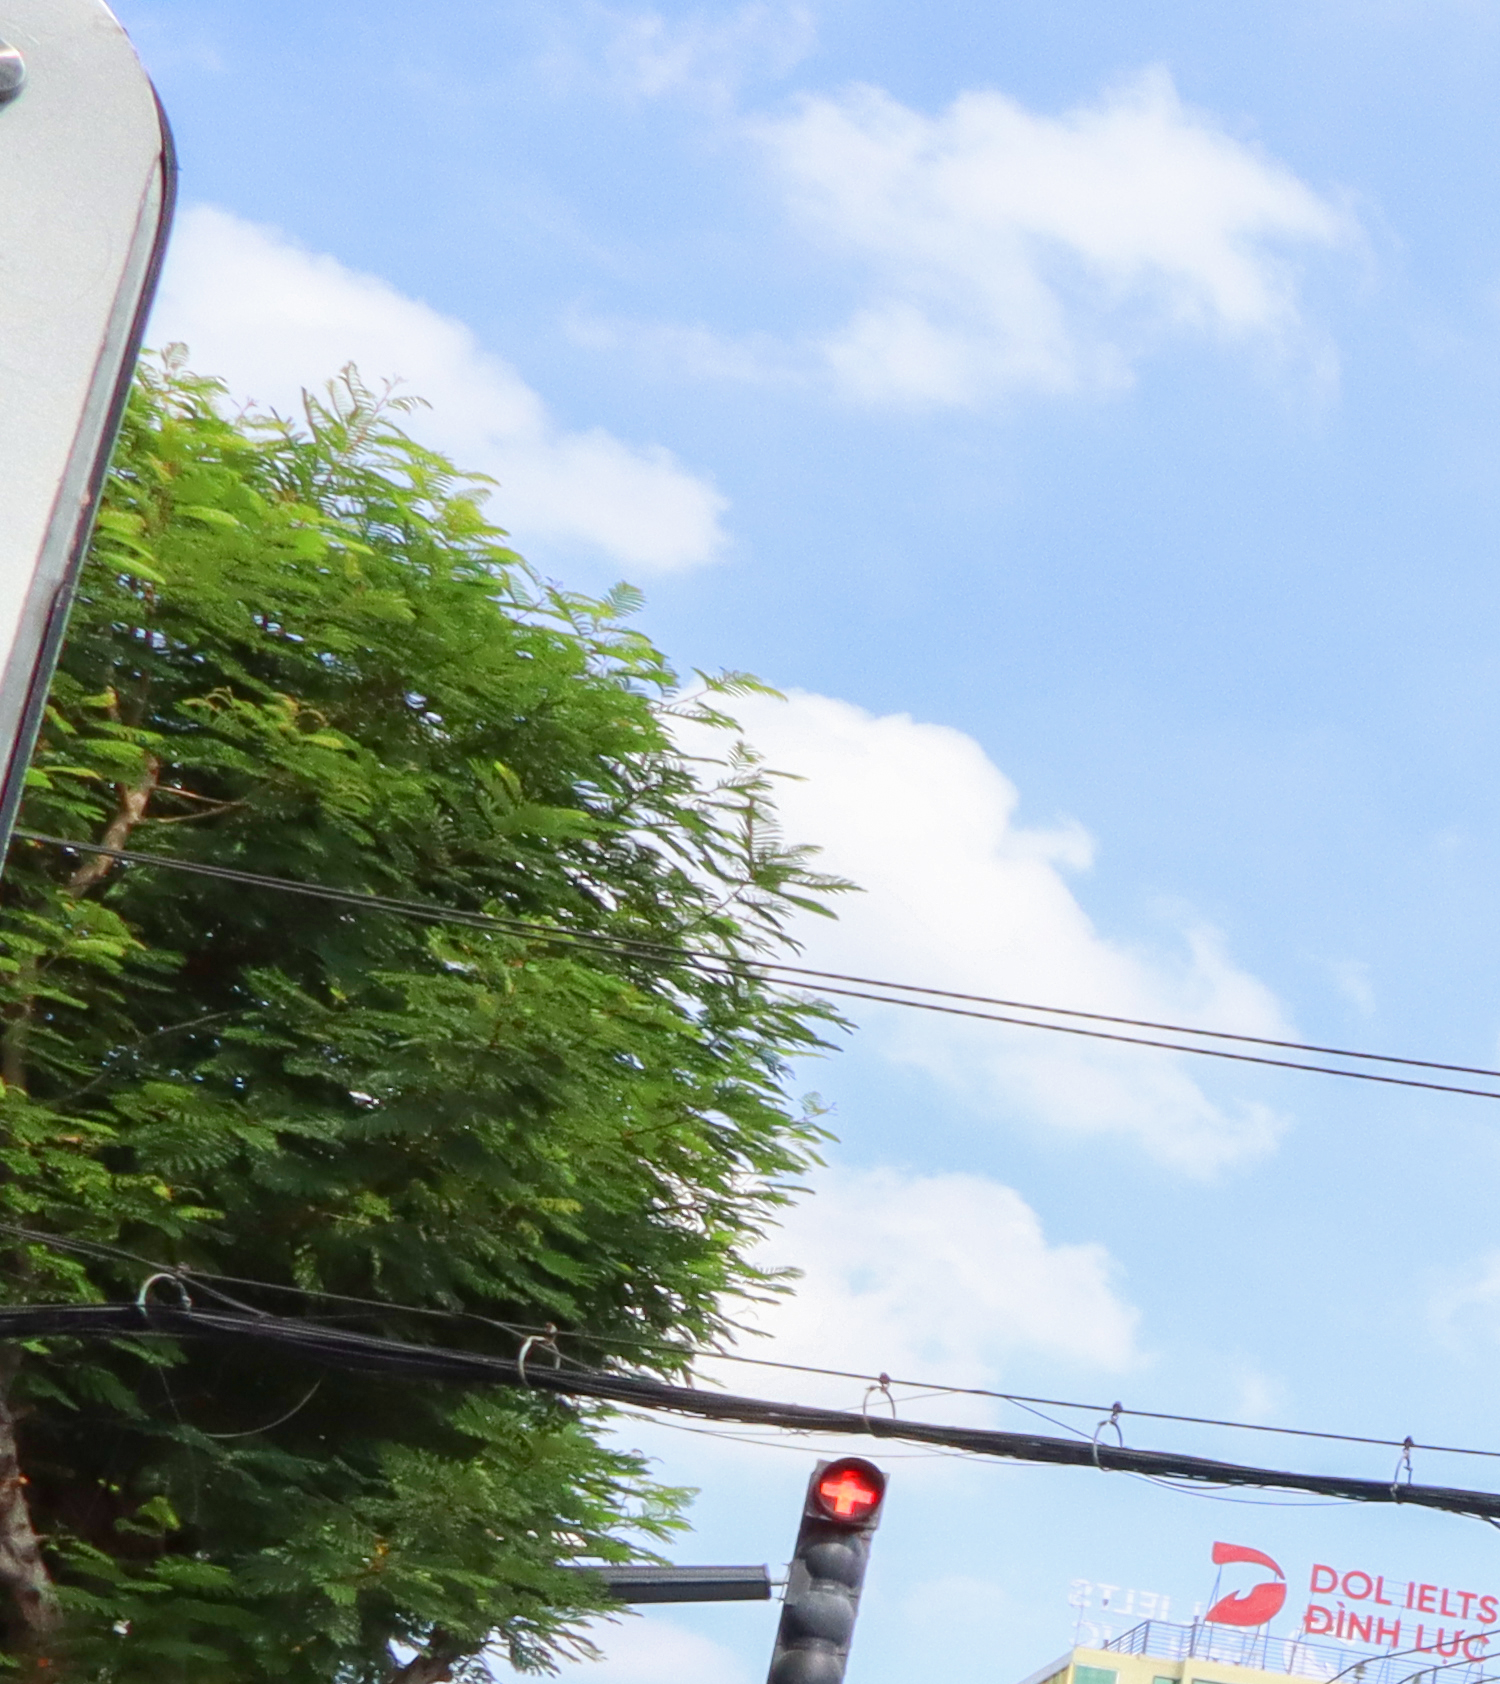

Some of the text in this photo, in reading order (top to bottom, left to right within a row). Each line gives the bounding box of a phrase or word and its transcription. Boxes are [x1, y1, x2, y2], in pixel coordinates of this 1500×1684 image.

[1311, 1563, 1500, 1625] DOL IELTS
[1304, 1600, 1492, 1664] ĐÌNH LỰC
